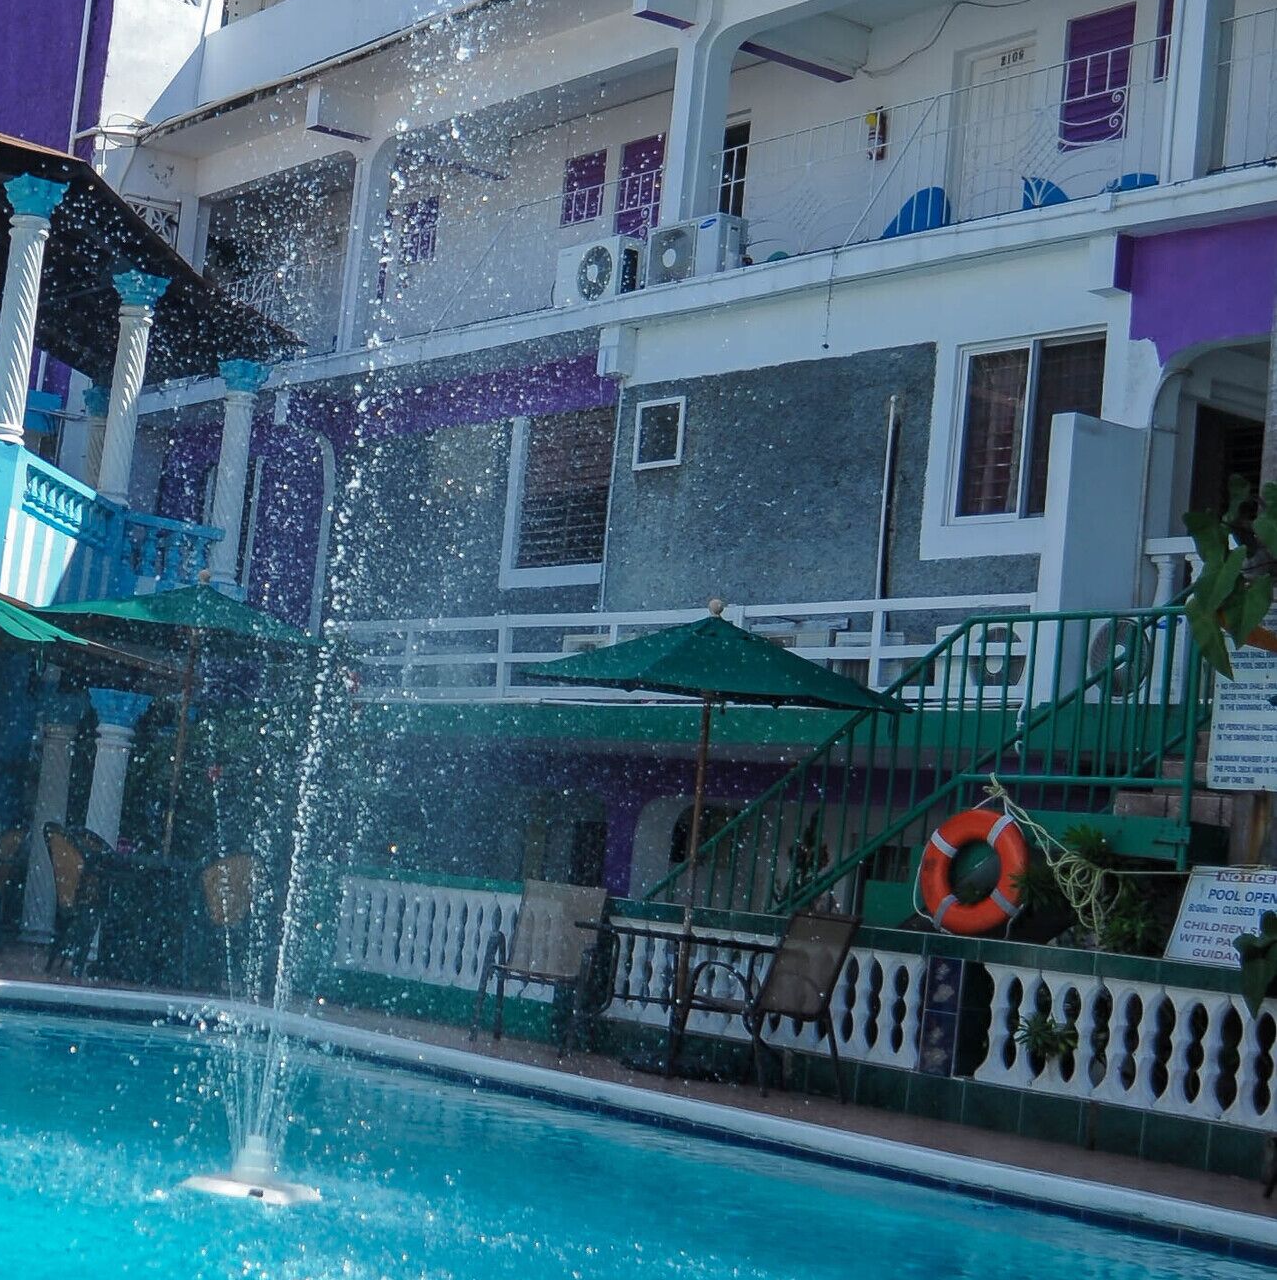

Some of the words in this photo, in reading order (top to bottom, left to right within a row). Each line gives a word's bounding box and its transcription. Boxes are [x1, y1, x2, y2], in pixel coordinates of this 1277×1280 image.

[1218, 871, 1276, 884] NOTICE
[1208, 888, 1240, 901] POOL
[1245, 891, 1277, 904] OPEN
[1222, 905, 1255, 916] CLOSED
[1183, 920, 1245, 934] CHILDREN
[1179, 933, 1212, 944] WITH
[1192, 948, 1241, 961] GUIDAN
